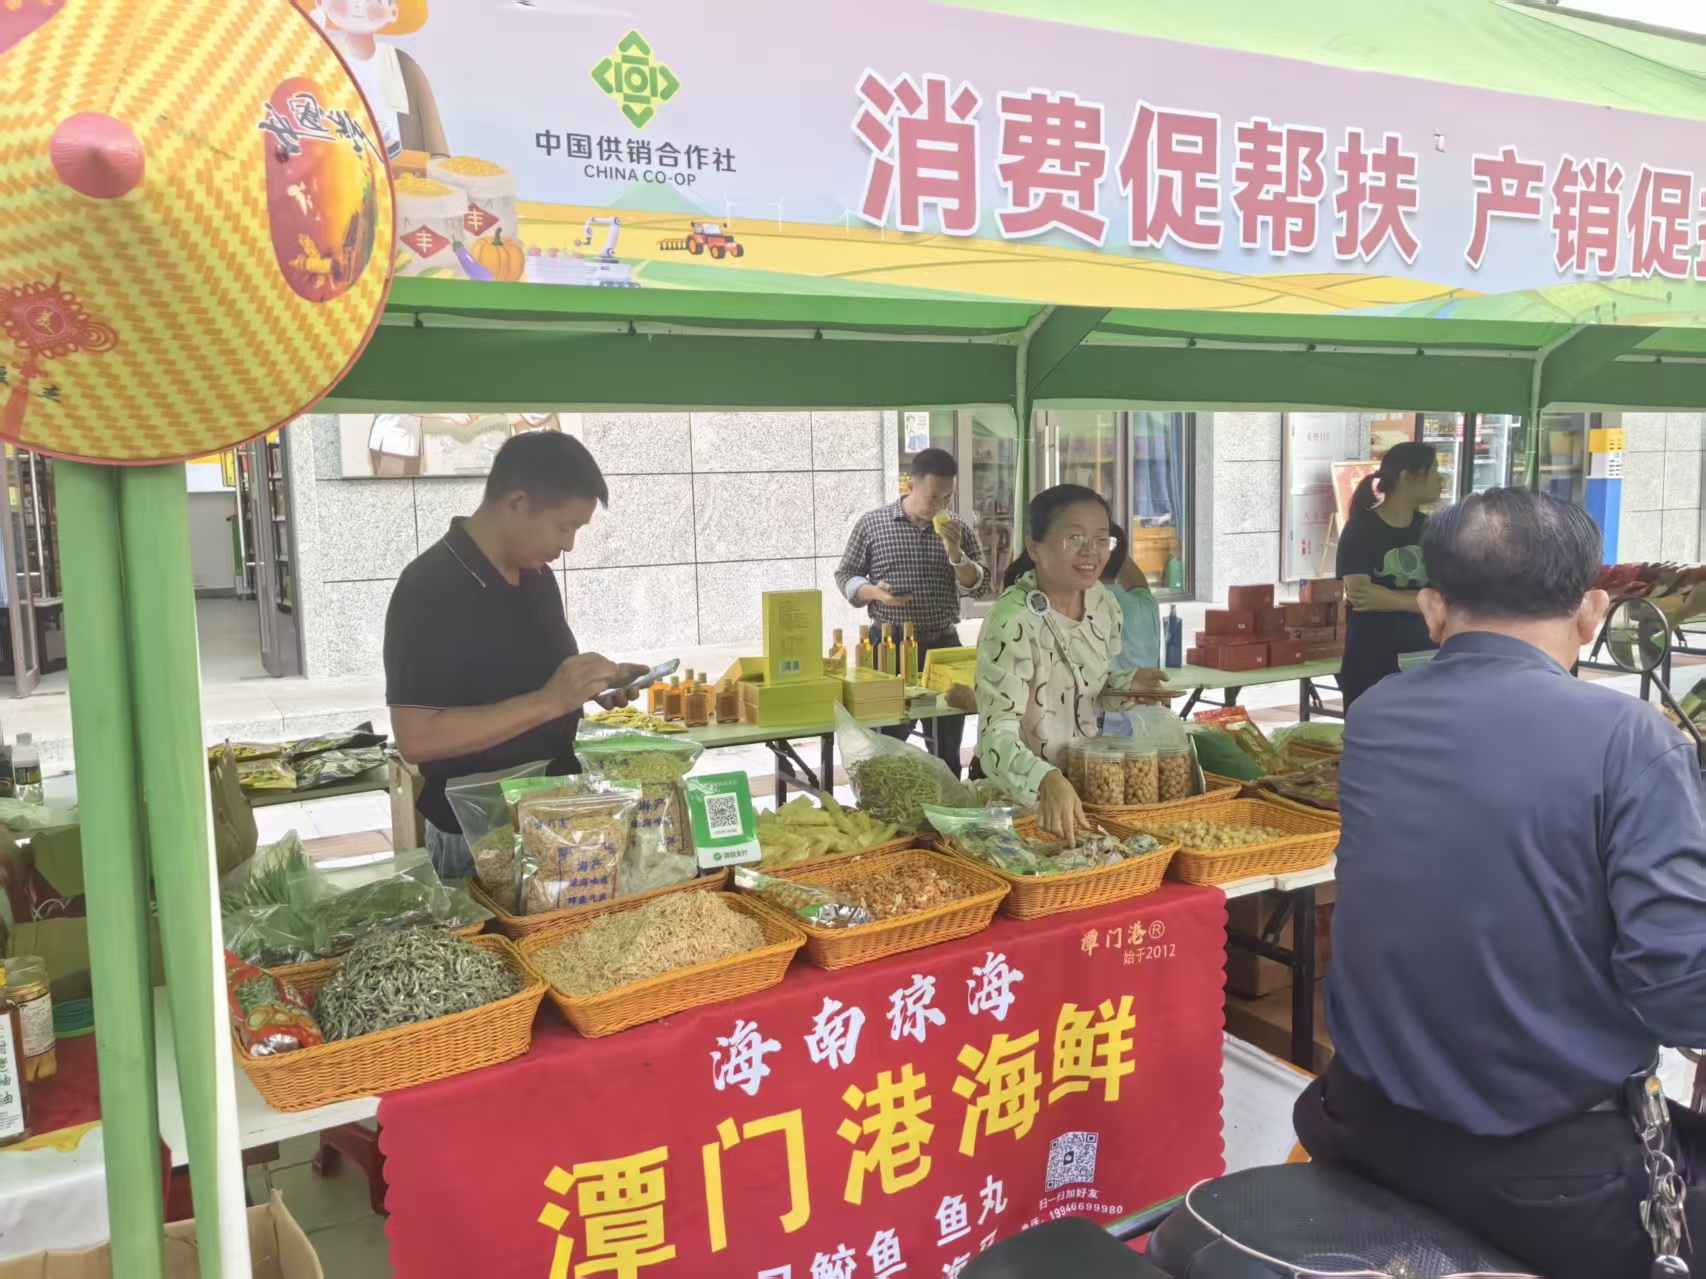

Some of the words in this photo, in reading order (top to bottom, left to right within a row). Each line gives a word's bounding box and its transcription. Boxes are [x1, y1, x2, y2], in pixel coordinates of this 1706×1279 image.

[535, 129, 737, 173] 中国供销合作社
[584, 164, 639, 182] CHINA
[643, 170, 696, 187] CO-OP
[854, 69, 1419, 263] 消费促帮扶
[1466, 148, 1706, 281] 产销促
[1123, 943, 1177, 966] 始于2012
[711, 950, 1024, 1096] 海南琼海
[537, 995, 1135, 1279] 潭门港海鲜
[758, 1228, 907, 1279] 鲛鱼
[935, 1174, 1008, 1247] 鱼丸
[1049, 1202, 1124, 1220] 19946699980
